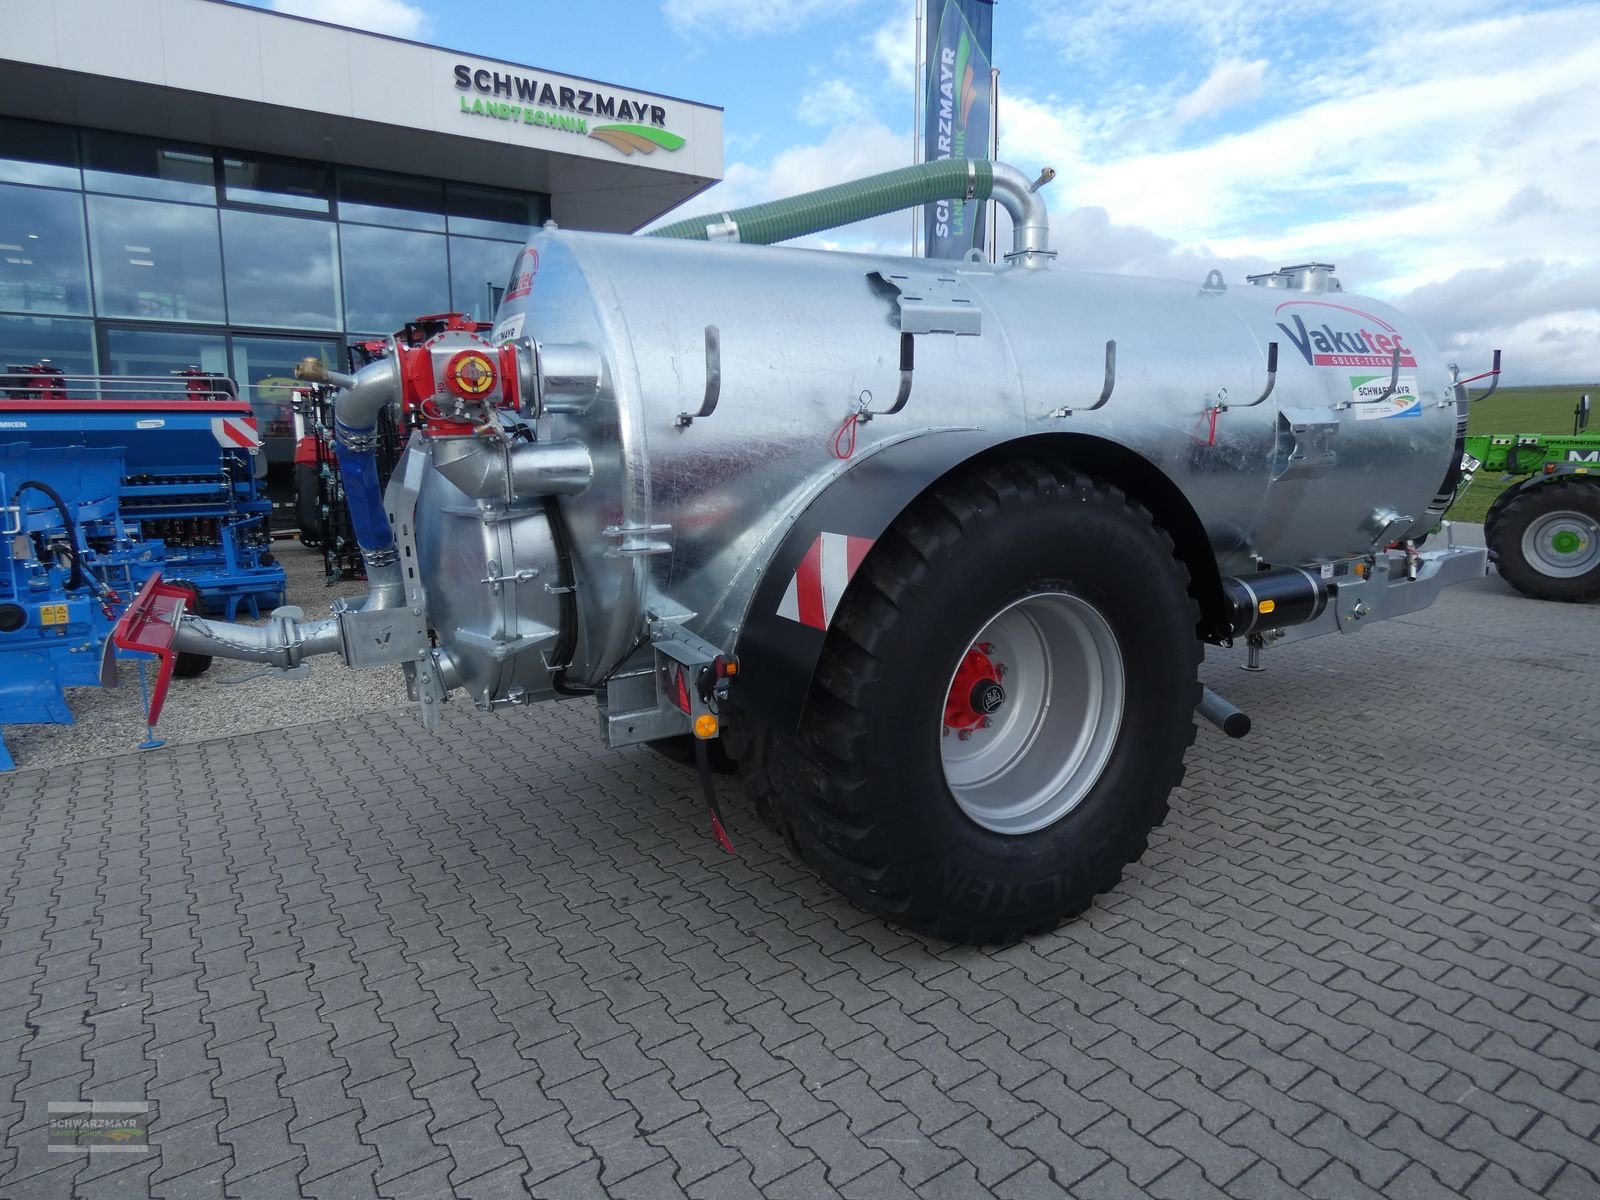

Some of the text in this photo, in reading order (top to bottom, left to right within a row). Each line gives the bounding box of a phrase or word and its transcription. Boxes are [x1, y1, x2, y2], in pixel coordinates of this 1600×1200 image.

[454, 64, 666, 127] SCHWARZMAYR
[460, 95, 588, 134] LANDTECHNIK
[935, 48, 955, 238] SCRZMAYR
[952, 130, 966, 236] LANDNIK
[1275, 314, 1411, 366] Vakutec
